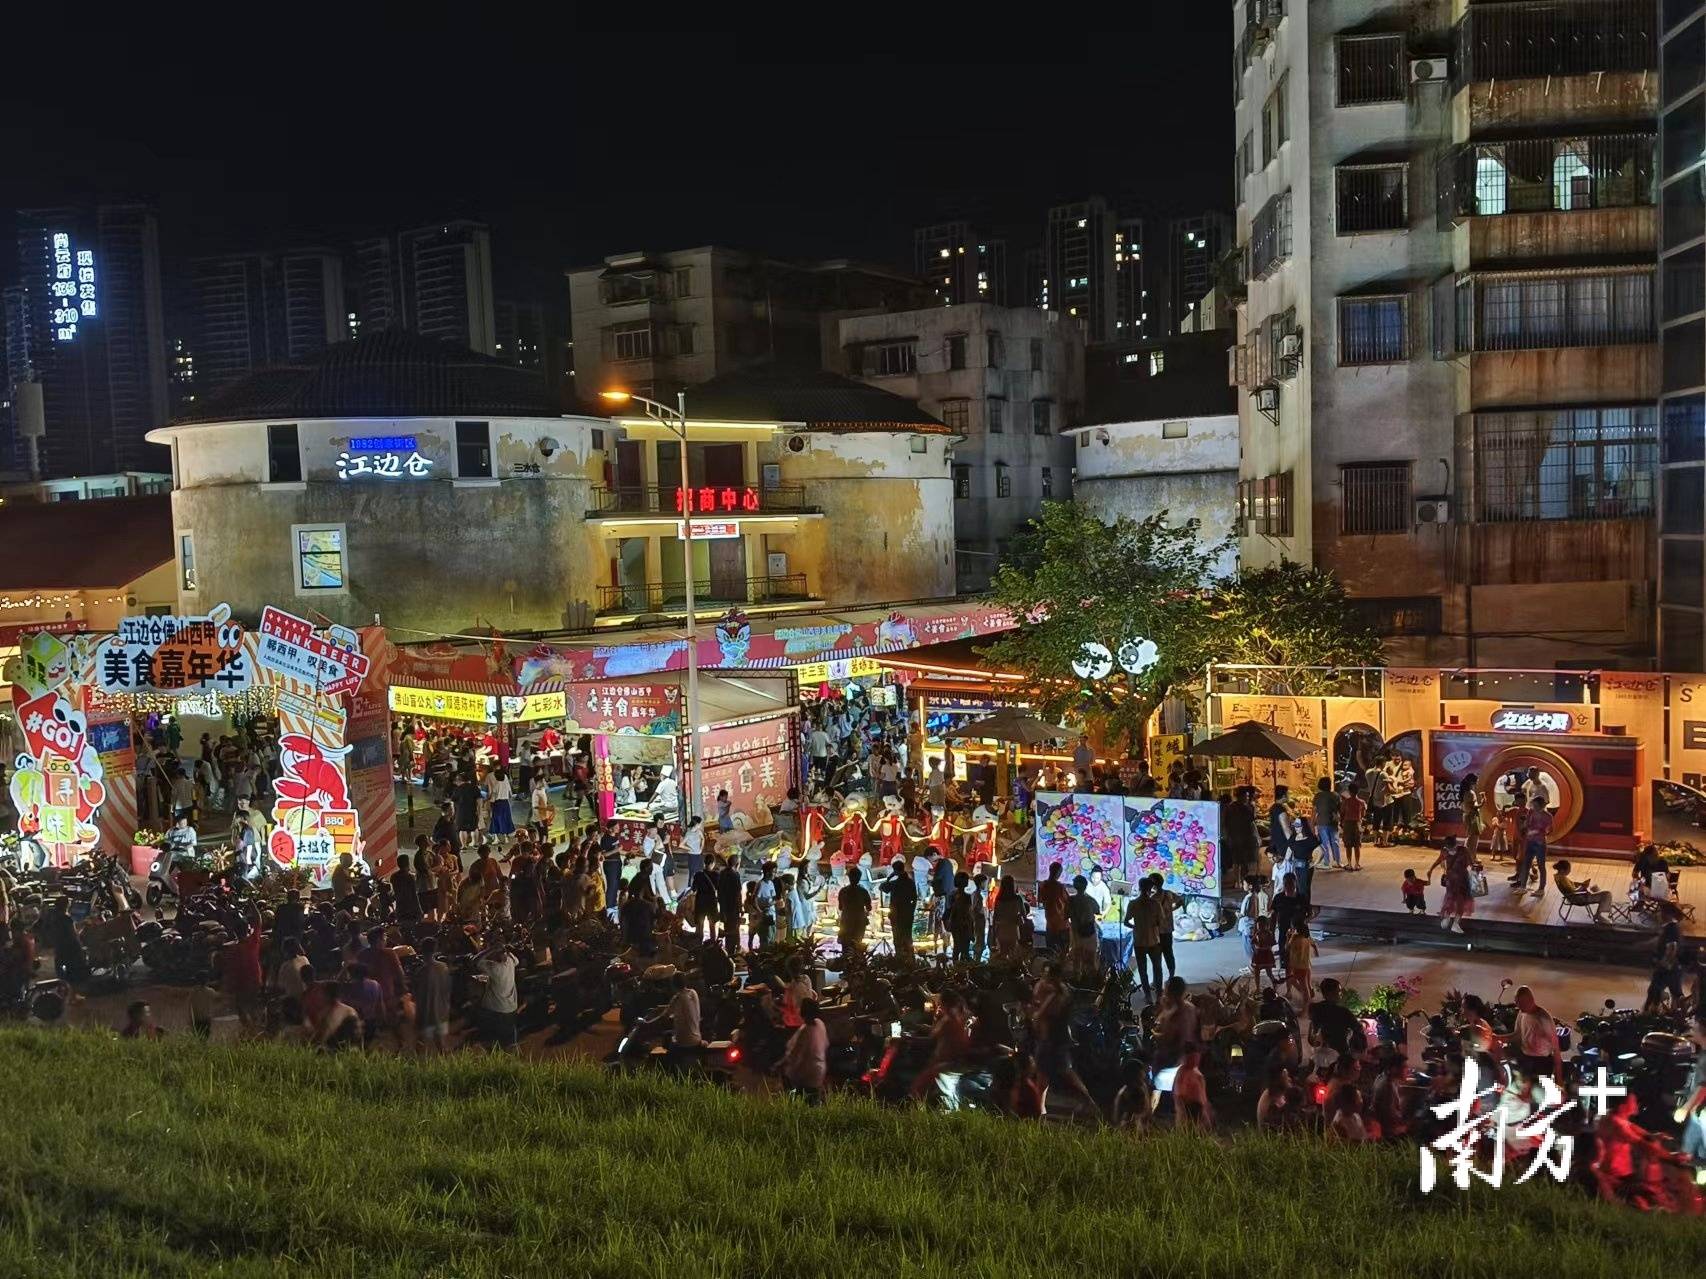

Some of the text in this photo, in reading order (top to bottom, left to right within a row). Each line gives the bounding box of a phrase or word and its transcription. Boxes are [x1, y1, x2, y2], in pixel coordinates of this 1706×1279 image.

[335, 452, 434, 479] 江边仓
[123, 620, 216, 646] 江边仓佛山西甲
[263, 621, 312, 650] DRINK
[320, 644, 361, 669] BEER
[104, 649, 246, 689] 美食嘉年华
[346, 676, 359, 686] LIFE
[532, 696, 563, 712] 七彩水
[601, 697, 629, 717] 美食
[55, 778, 74, 805] 寻
[325, 816, 345, 826] BBQ
